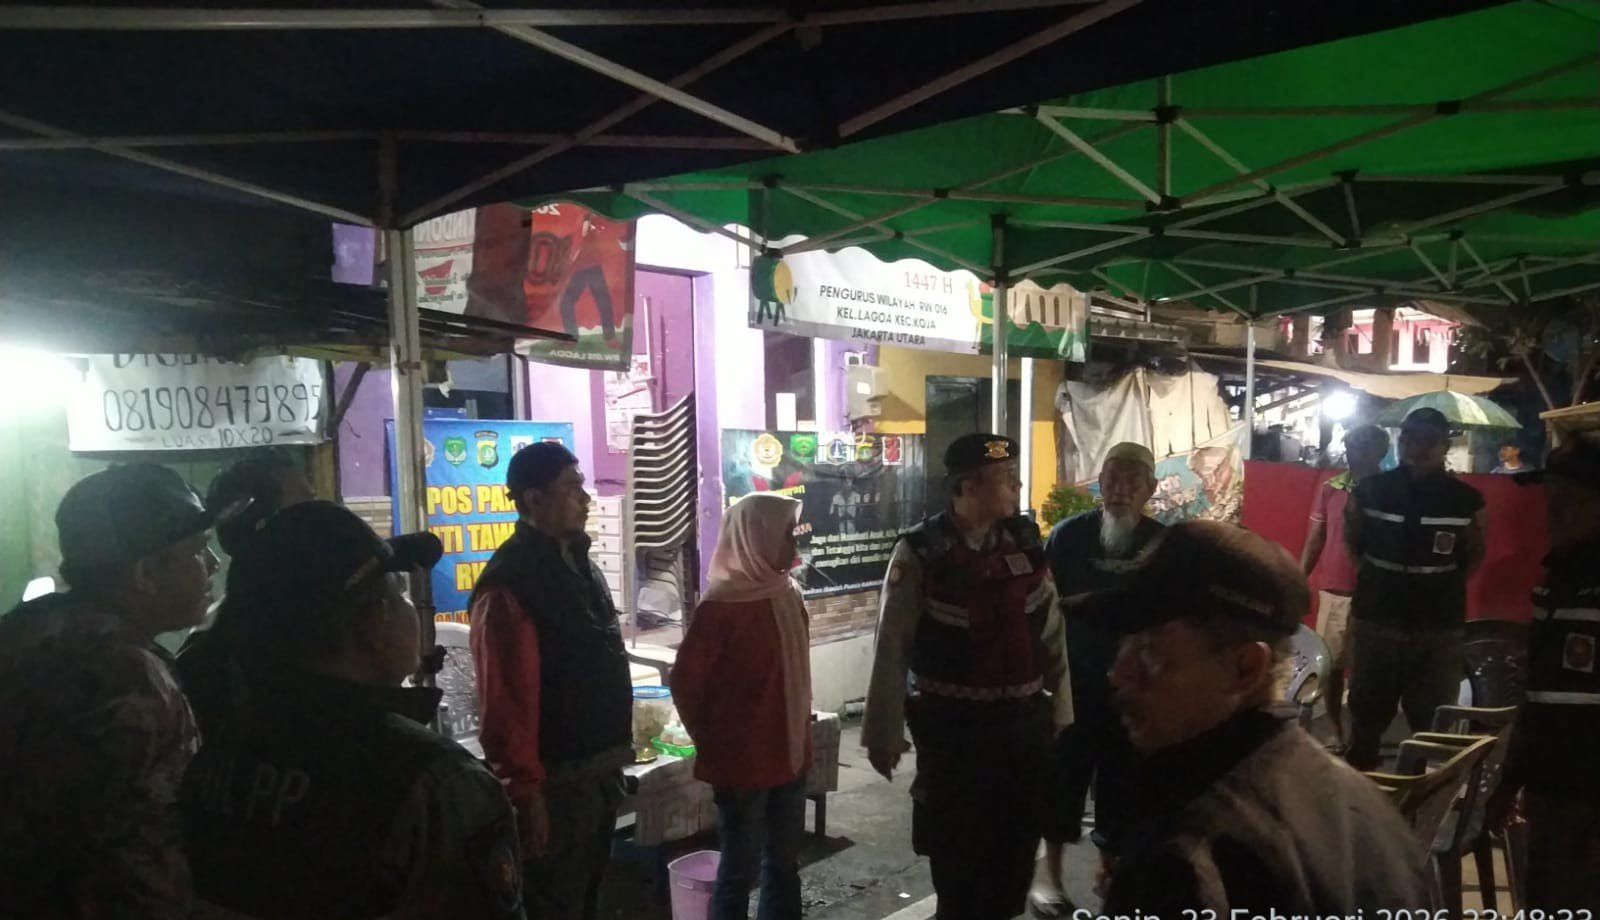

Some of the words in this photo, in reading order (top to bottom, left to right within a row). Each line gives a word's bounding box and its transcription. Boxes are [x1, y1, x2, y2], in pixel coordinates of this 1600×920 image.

[905, 271, 937, 291] 1447
[943, 276, 953, 294] H
[819, 285, 875, 304] PENGURUS
[877, 293, 915, 310] WILAYAH
[919, 301, 932, 313] RW
[836, 306, 892, 324] KEL.LAGOA
[851, 327, 894, 342] JAKARTA
[896, 332, 925, 345] UTARA
[426, 484, 473, 516] POS
